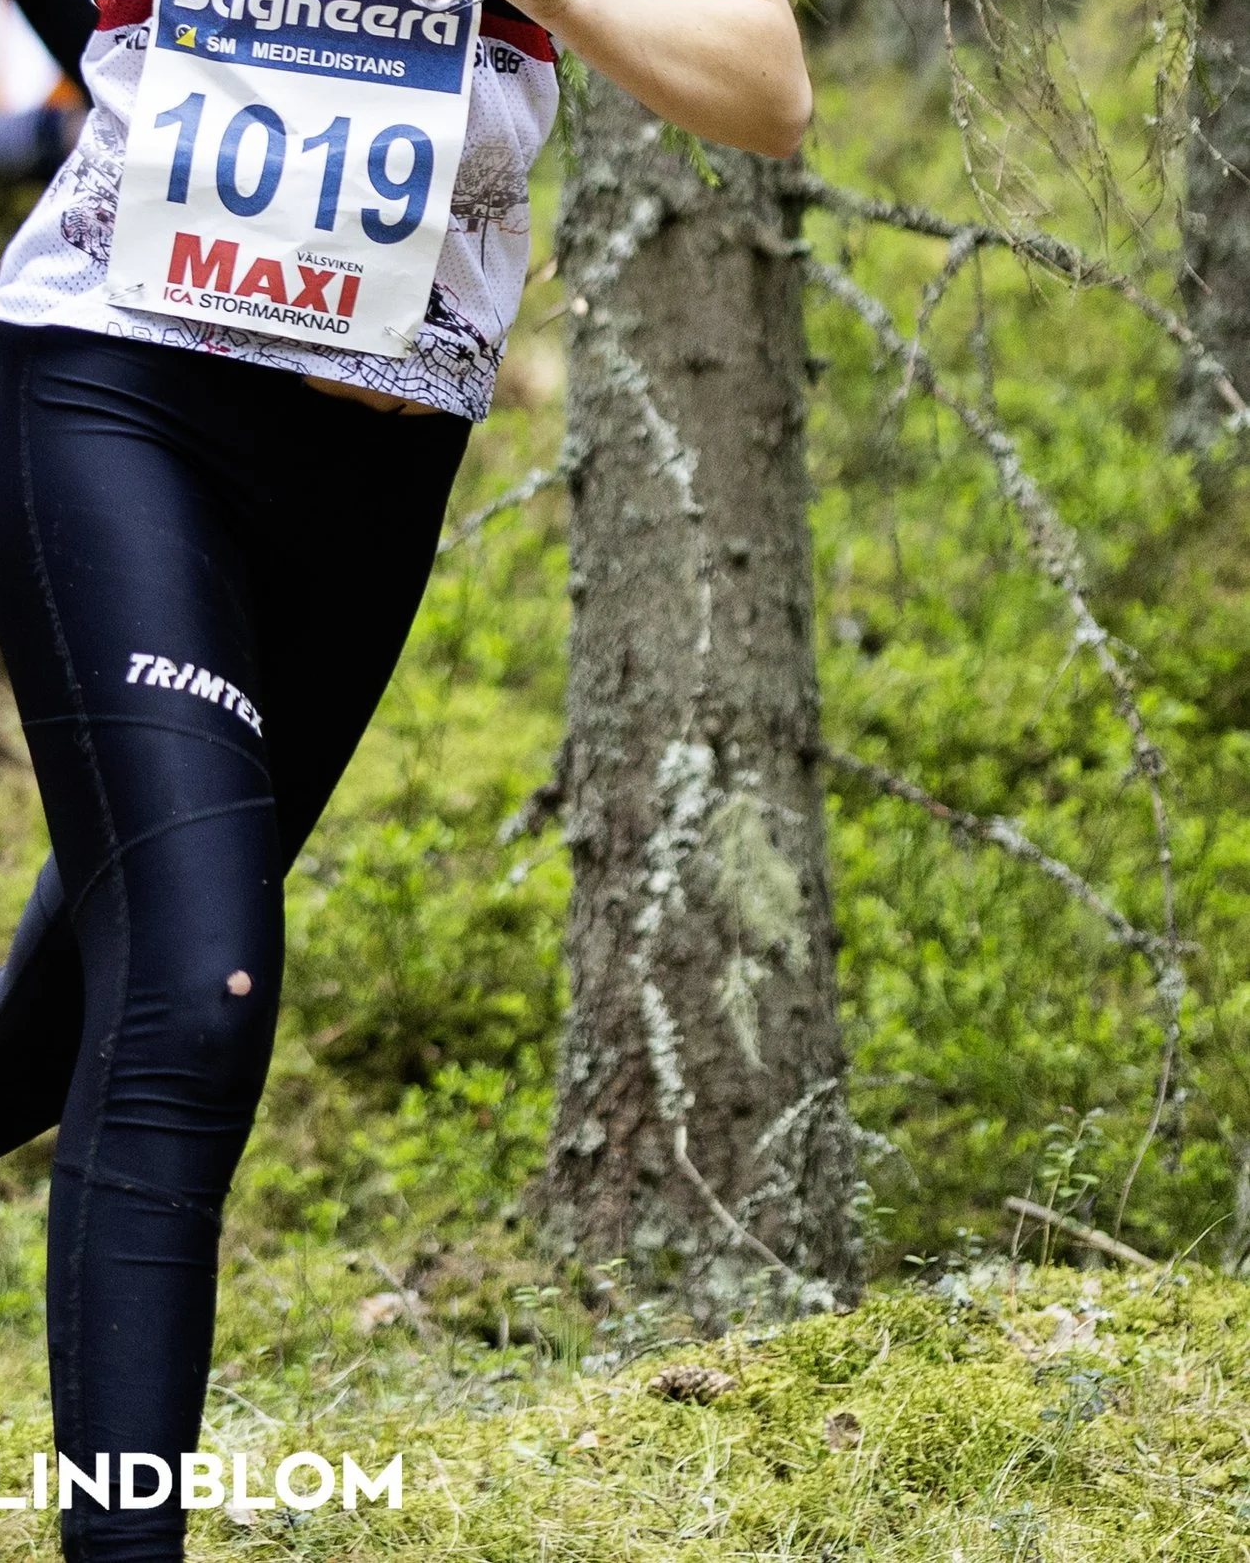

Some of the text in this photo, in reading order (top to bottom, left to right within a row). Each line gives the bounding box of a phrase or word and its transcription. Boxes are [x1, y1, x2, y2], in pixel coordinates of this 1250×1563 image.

[206, 36, 406, 77] SM MEDELDISTANS
[154, 92, 435, 245] 1019
[167, 231, 361, 318] MAXI
[297, 250, 364, 274] VÄLSVIKEN
[163, 286, 351, 335] ICA STORMARKNAD
[125, 652, 264, 738] TRIMTEX
